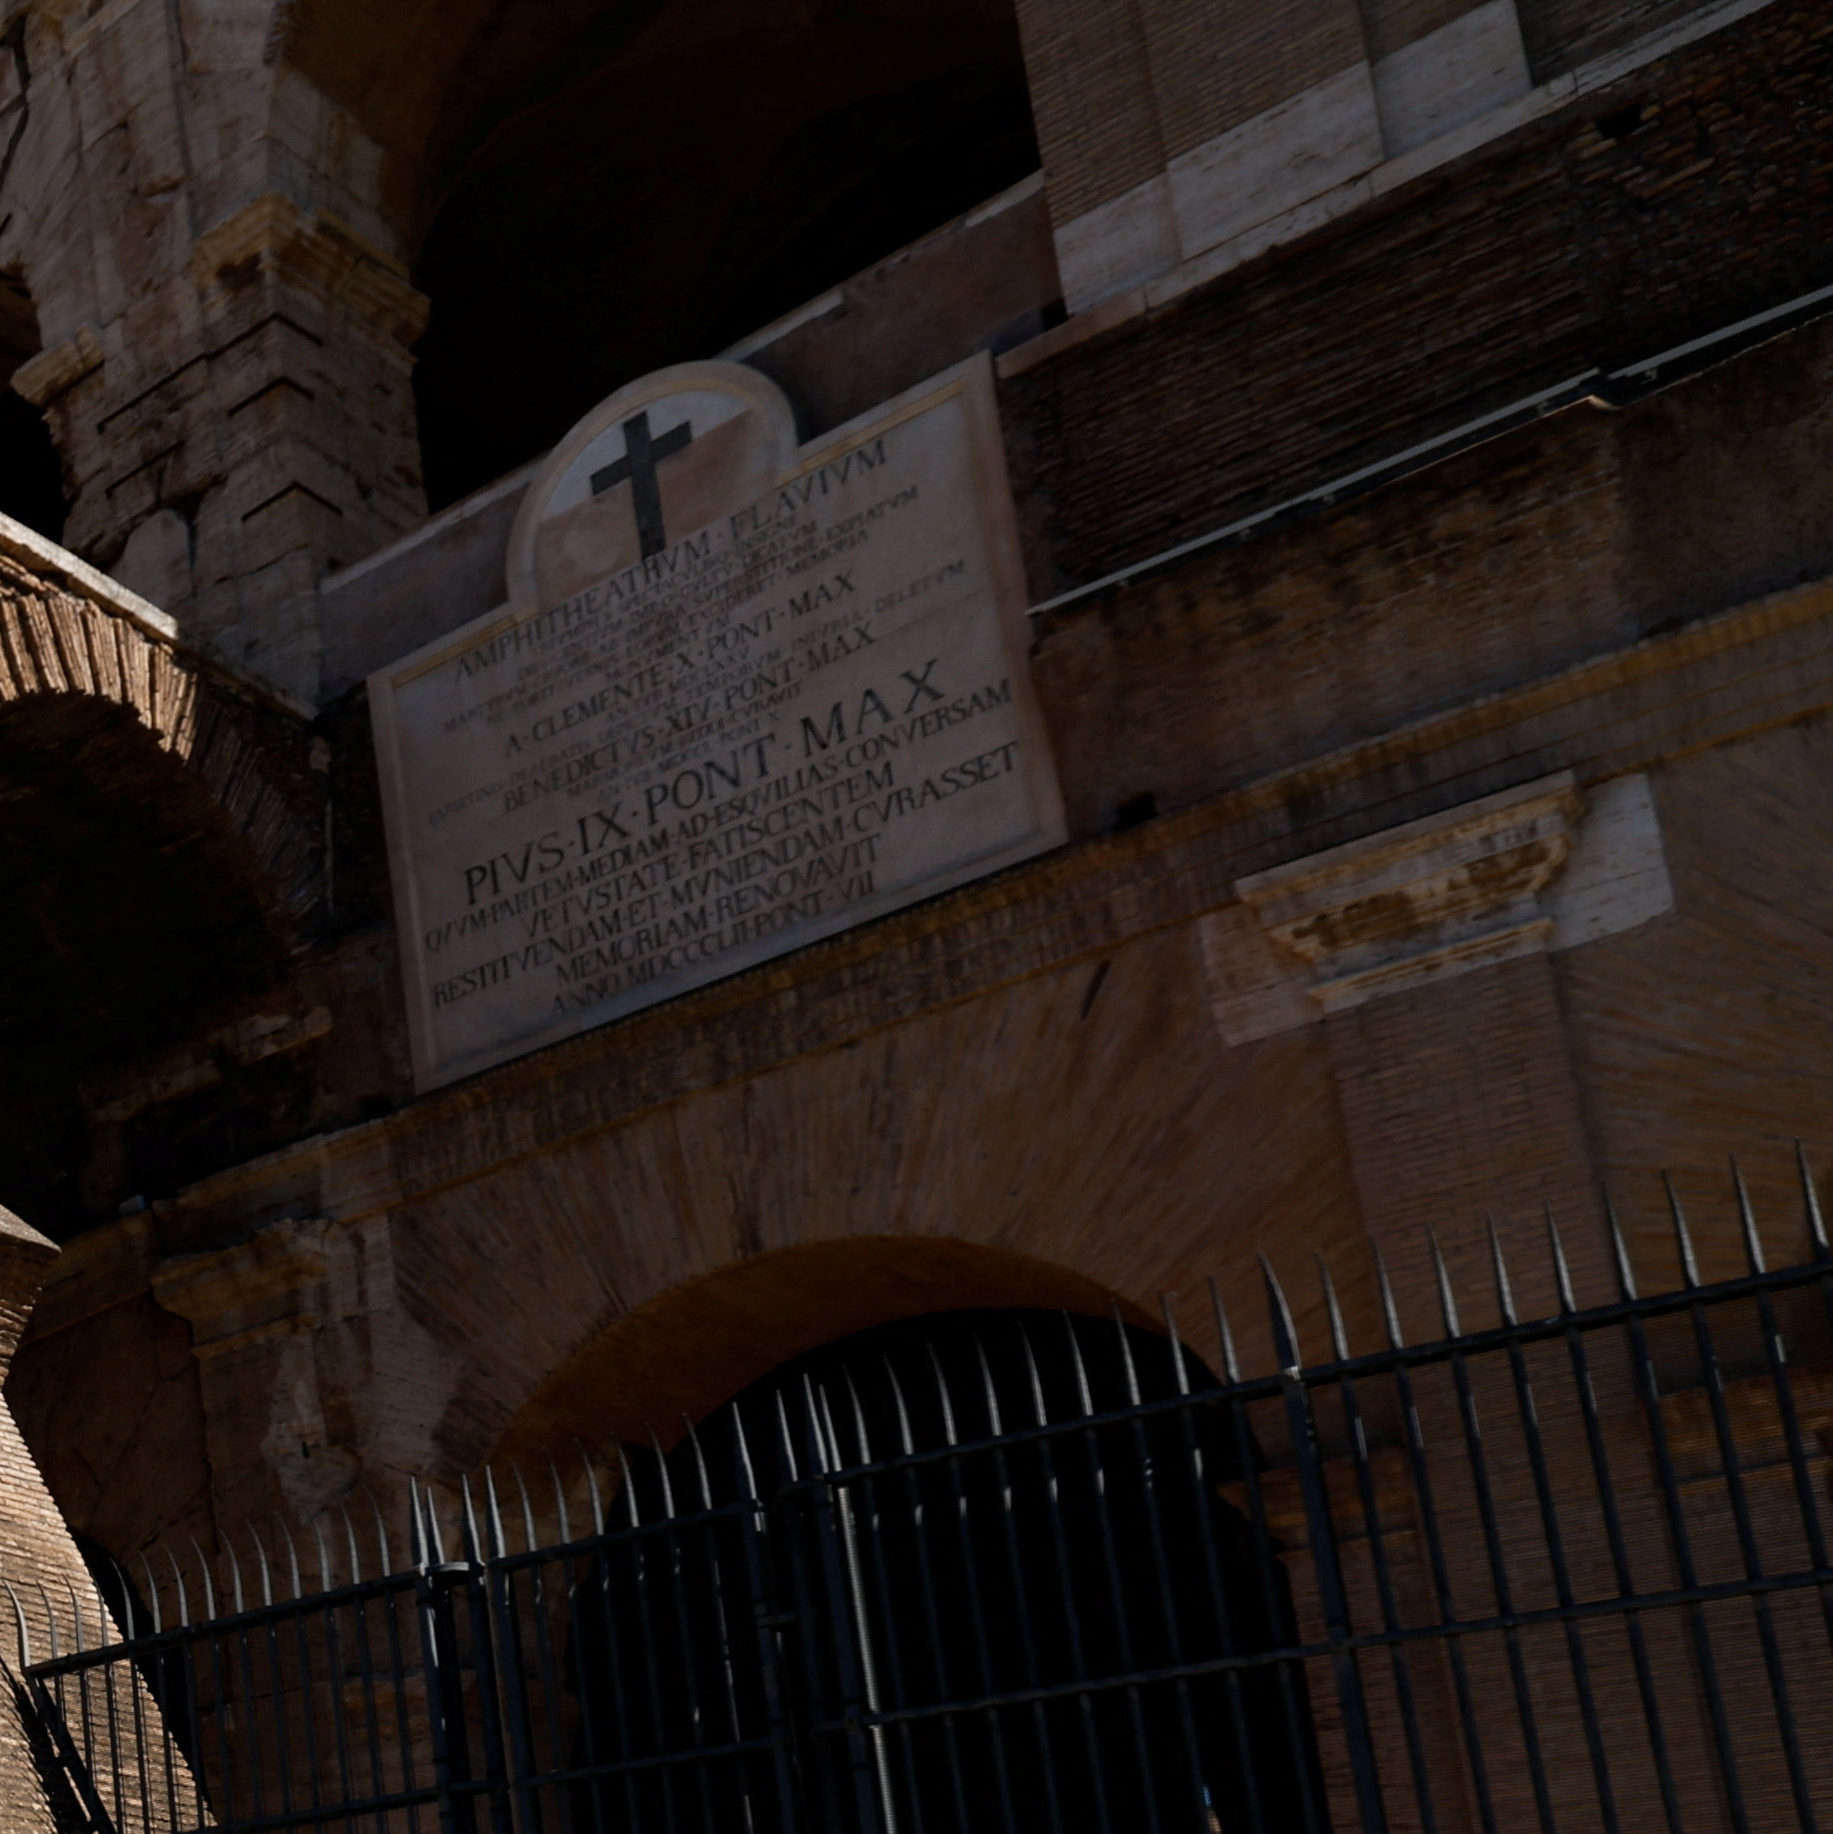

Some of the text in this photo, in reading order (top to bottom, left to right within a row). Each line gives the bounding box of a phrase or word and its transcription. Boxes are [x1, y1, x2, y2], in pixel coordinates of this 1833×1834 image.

[453, 529, 710, 684] AMPHITHEATRVM
[730, 438, 887, 541] FLAVIVM
[504, 722, 656, 813] BENEDICTVS
[723, 655, 797, 711] PONT
[805, 618, 876, 673] MAX
[530, 661, 665, 745] CLEMENTE
[675, 645, 696, 674] X
[706, 605, 779, 660] PONT
[788, 567, 857, 620] MAX
[463, 827, 566, 907] PIVS
[576, 797, 630, 857] IX
[642, 731, 780, 827] PONT
[799, 656, 945, 758] MAX
[491, 869, 574, 924] PARTEM
[578, 827, 669, 886] MEDIAM
[674, 809, 710, 844] AD
[713, 753, 838, 827] ESQVILIAS
[844, 676, 1012, 771] CONVERSAM
[522, 851, 682, 940] VETVSTATE
[687, 760, 895, 871] FATISCENTEM
[627, 891, 663, 928] ET
[670, 814, 845, 910] MVNIENDAM
[851, 740, 1021, 835] CVRASSET
[555, 832, 883, 989] MEMORIAM RENOVAVIT
[753, 888, 825, 938] PONT
